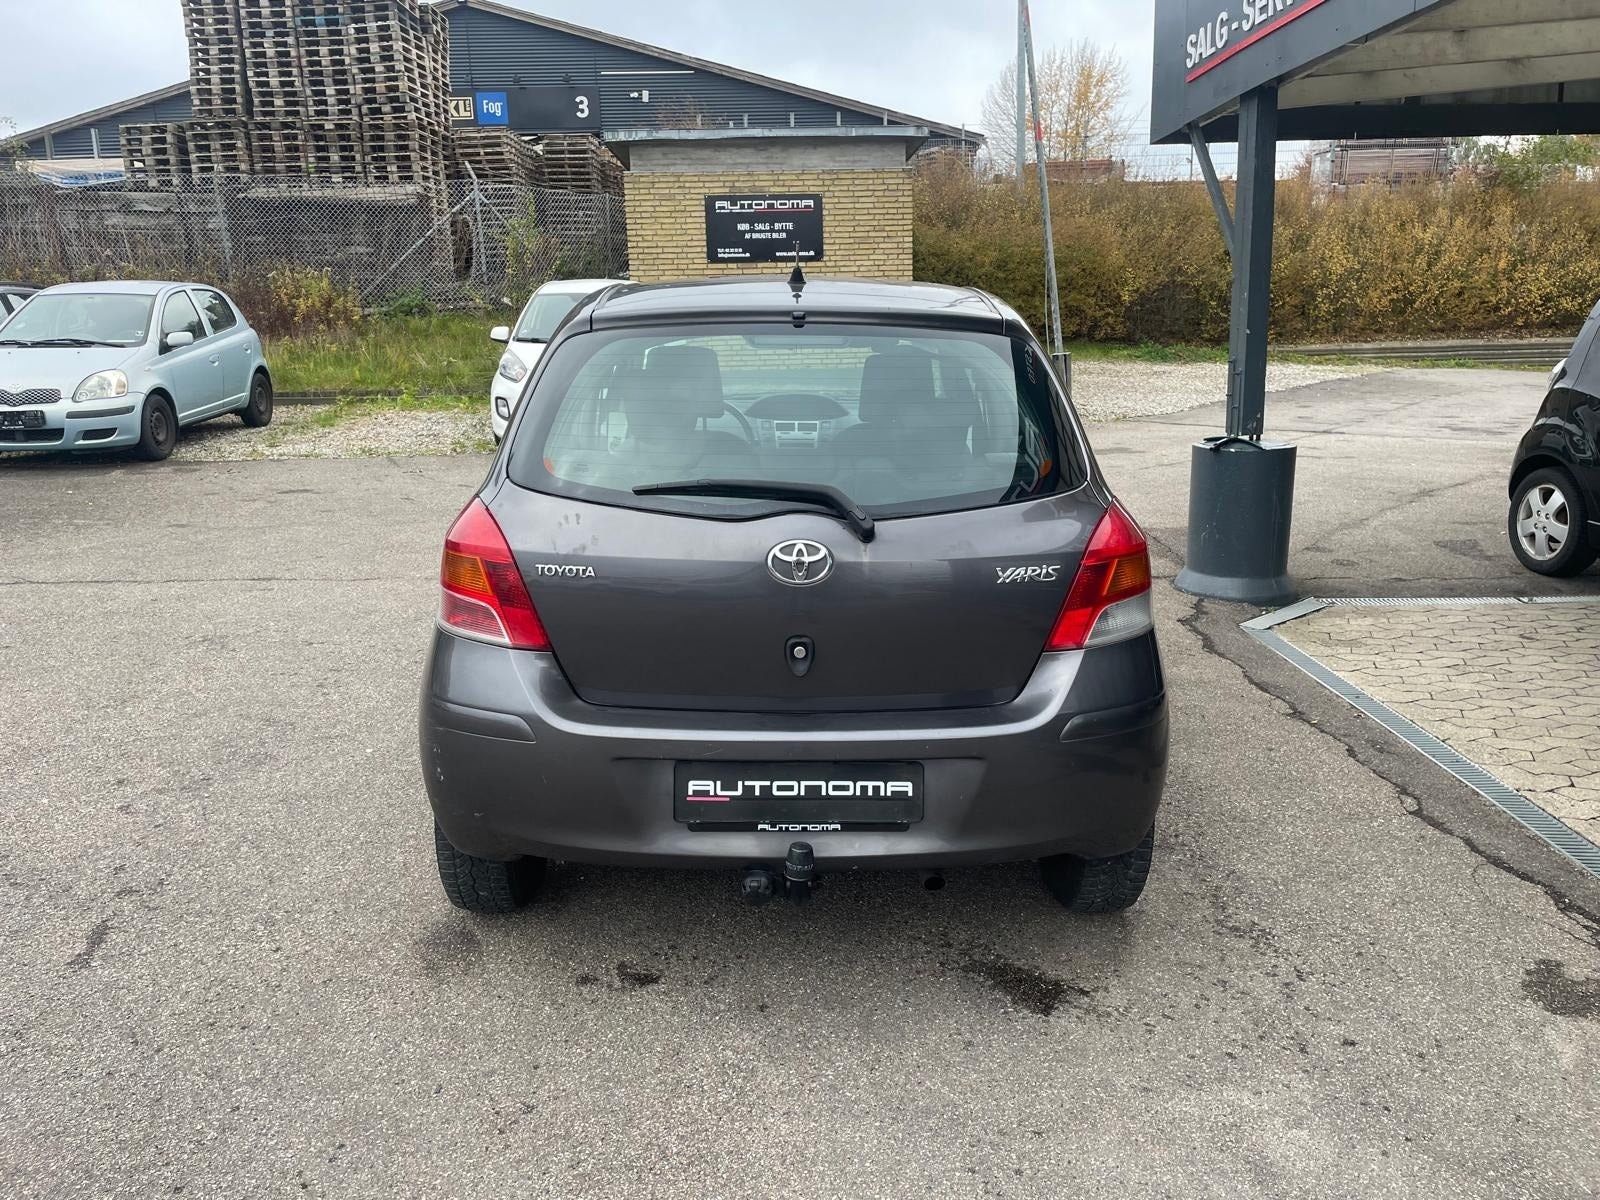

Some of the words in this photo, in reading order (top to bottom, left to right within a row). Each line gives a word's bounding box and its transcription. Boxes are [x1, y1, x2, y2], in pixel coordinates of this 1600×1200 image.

[1186, 11, 1229, 68] SALG
[1242, 0, 1294, 31] SE
[483, 99, 502, 116] Fog
[574, 95, 590, 118] 3
[715, 199, 814, 209] AUTONOMA
[754, 222, 770, 231] SALG
[774, 222, 794, 230] BYTTE
[535, 564, 596, 578] TOYOTA
[687, 780, 914, 797] AUTONOMA
